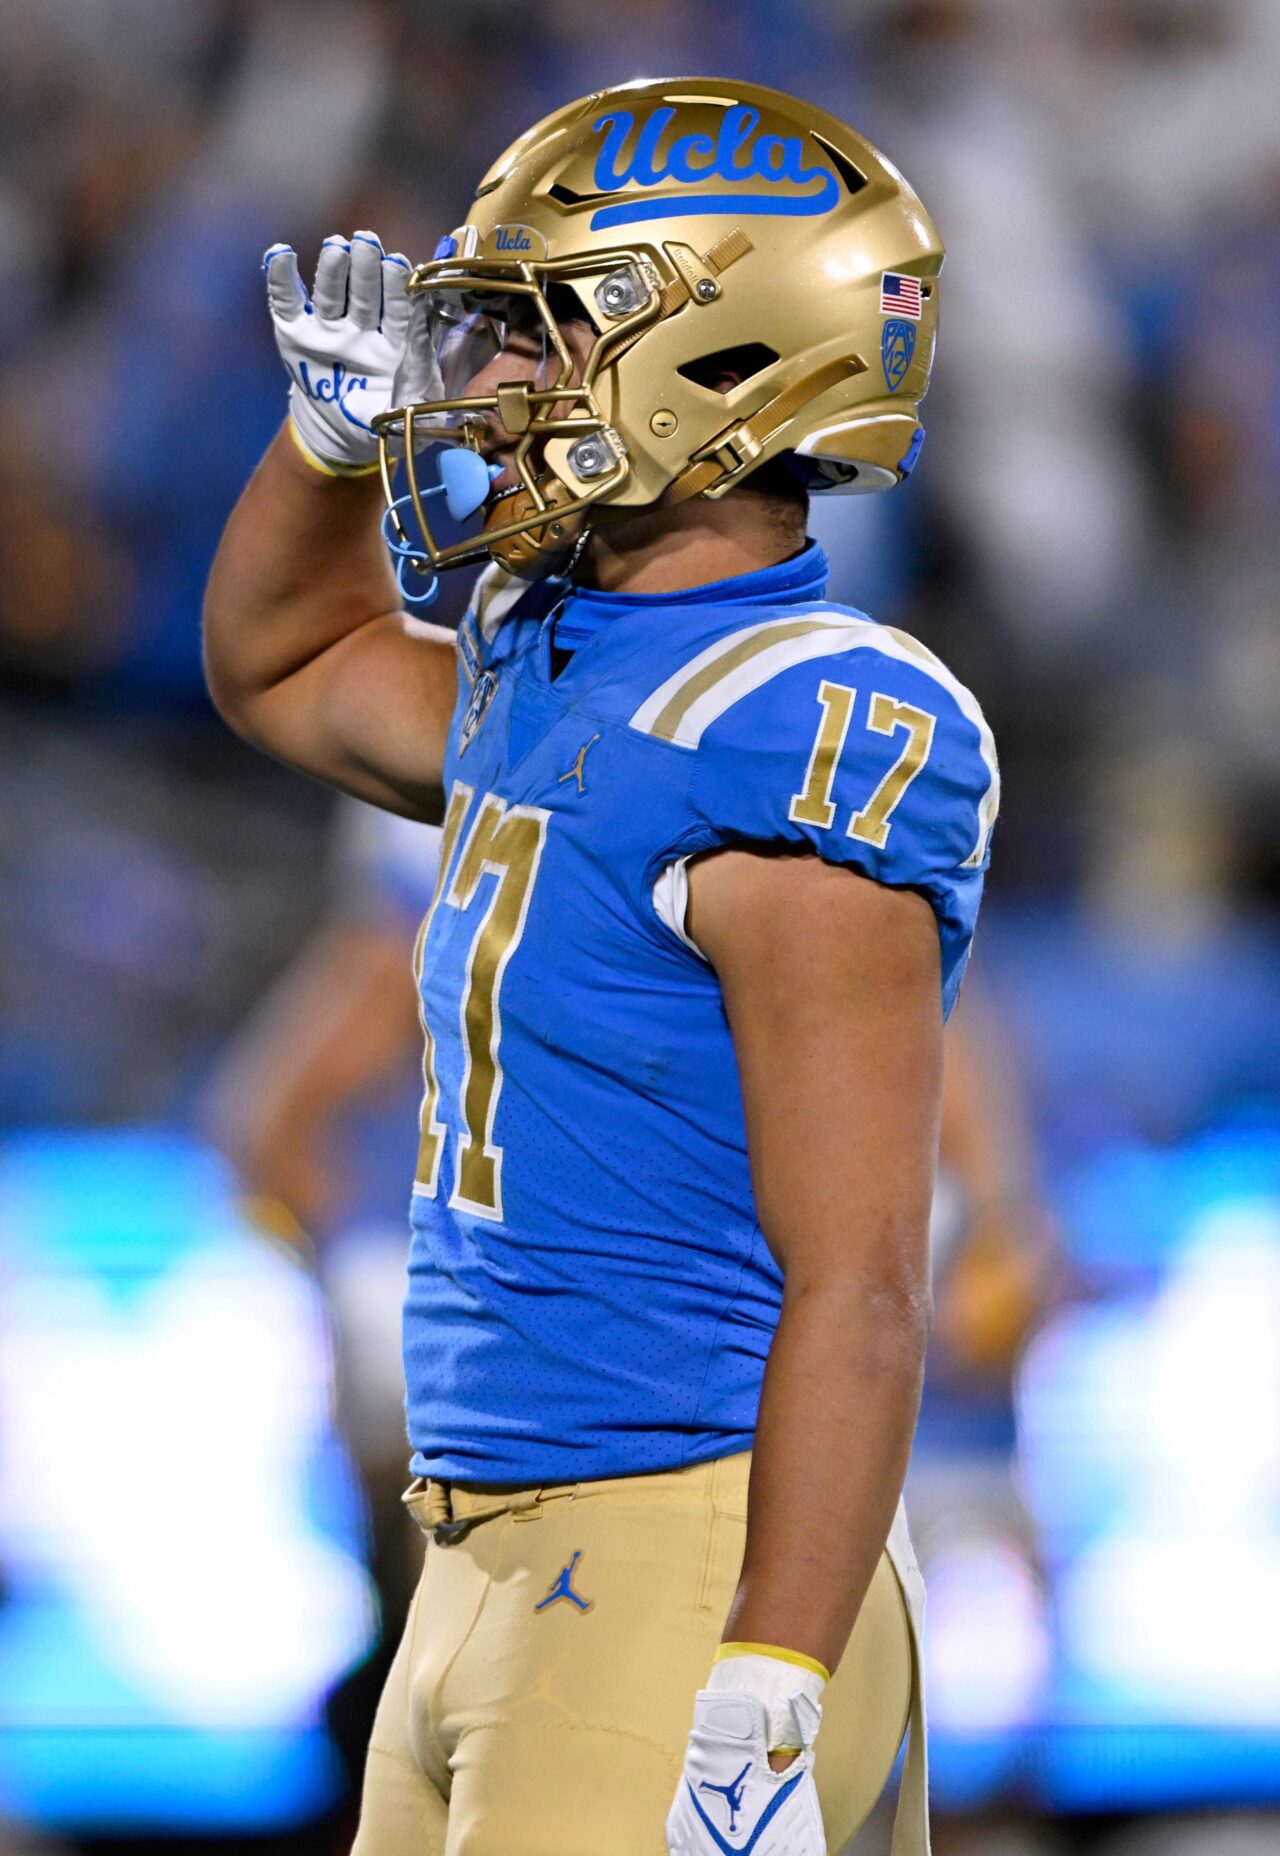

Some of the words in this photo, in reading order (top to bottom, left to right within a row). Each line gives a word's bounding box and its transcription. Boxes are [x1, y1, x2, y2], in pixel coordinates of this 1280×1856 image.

[592, 105, 839, 192] Ucla
[496, 228, 531, 250] Ucla
[888, 351, 905, 376] 12
[788, 679, 937, 850] 17
[412, 779, 553, 1222] 17
